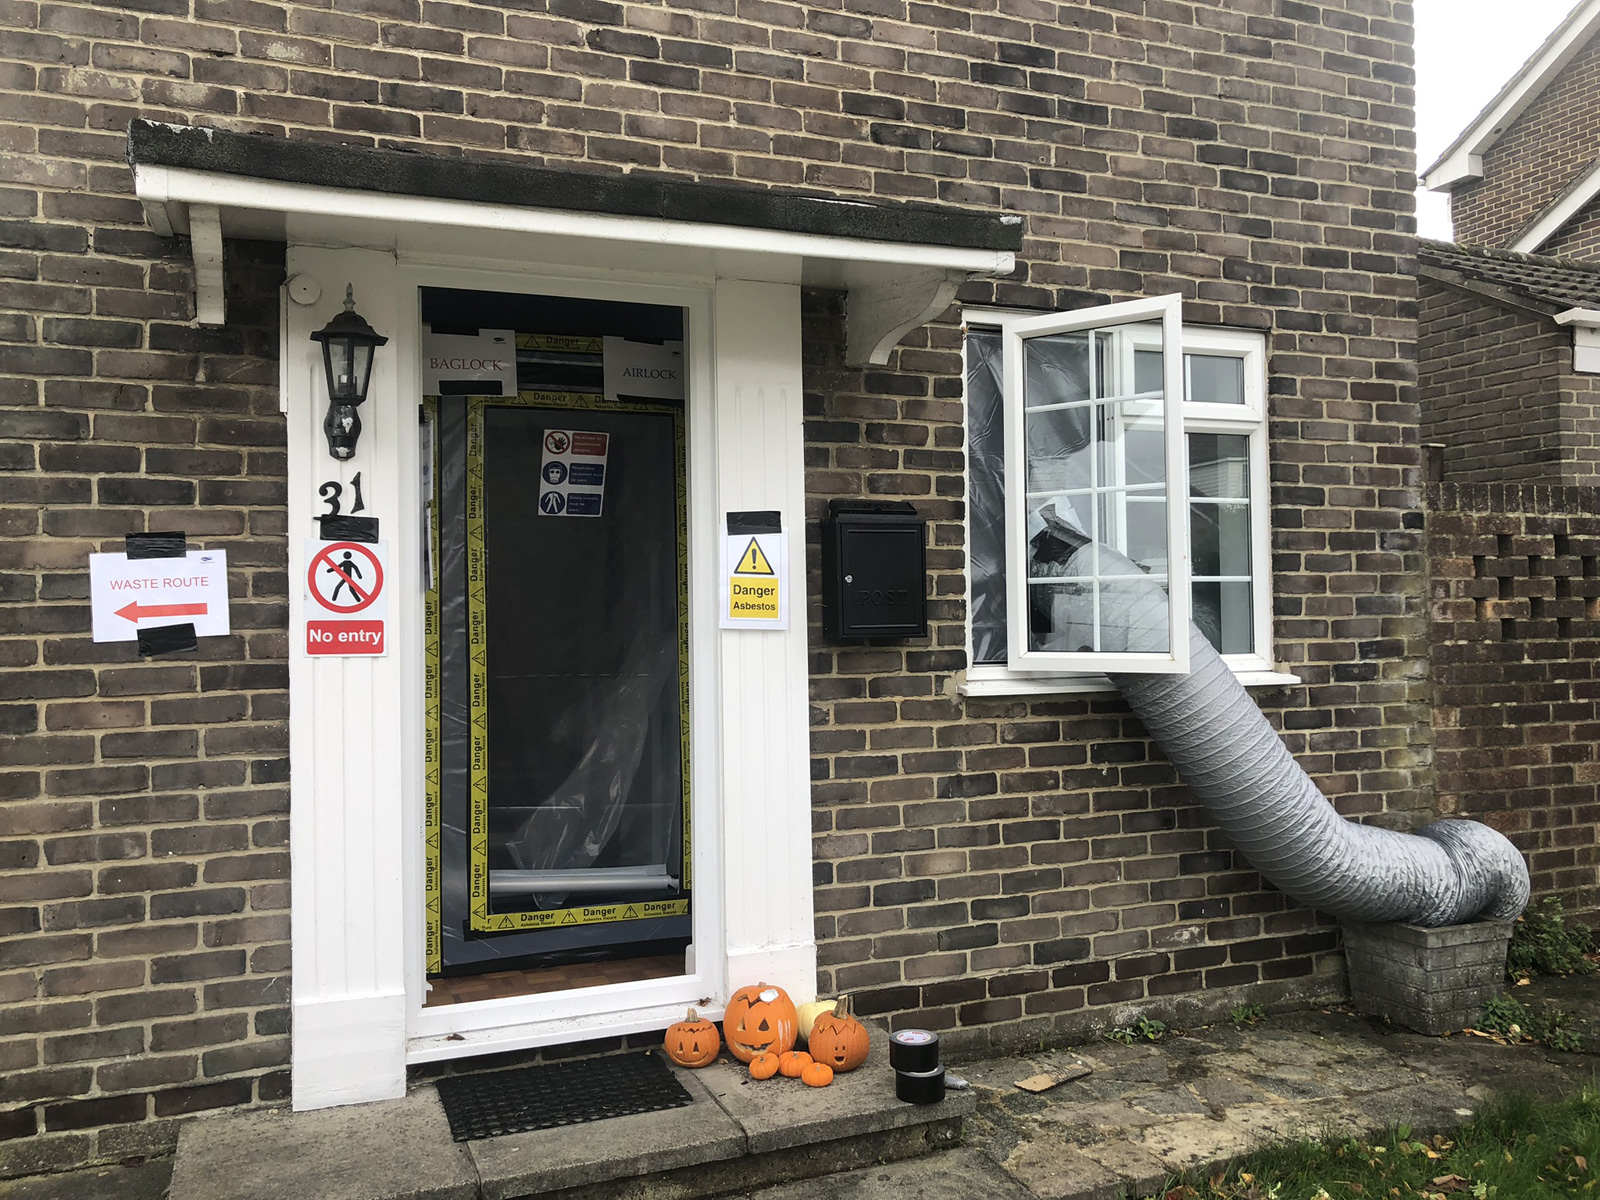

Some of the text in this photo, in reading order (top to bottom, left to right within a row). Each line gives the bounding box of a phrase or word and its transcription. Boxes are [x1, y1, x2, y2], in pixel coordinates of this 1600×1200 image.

[546, 336, 580, 346] Danger
[430, 358, 503, 371] BAGLOCK
[622, 367, 676, 380] AIRLOCK
[533, 392, 568, 402] Danger
[318, 471, 365, 515] 31
[468, 486, 478, 519] Danger
[470, 548, 480, 582] Danger
[110, 576, 210, 590] WASTE ROUTE
[733, 584, 776, 598] Danger
[858, 589, 908, 606] POST
[424, 600, 434, 635] Danger
[732, 601, 776, 611] Asbestos
[309, 628, 382, 646] No entry
[471, 610, 481, 644] Danger
[425, 664, 434, 698] Danger
[472, 673, 482, 708] Danger
[425, 728, 435, 762] Danger
[473, 736, 482, 770] Danger
[425, 792, 435, 827] Danger
[473, 800, 482, 834] Danger
[426, 856, 435, 891] Danger
[472, 864, 482, 898] Danger
[520, 912, 555, 923] Danger
[583, 907, 616, 918] Danger
[643, 902, 676, 913] Danger
[426, 921, 435, 956] Danger
